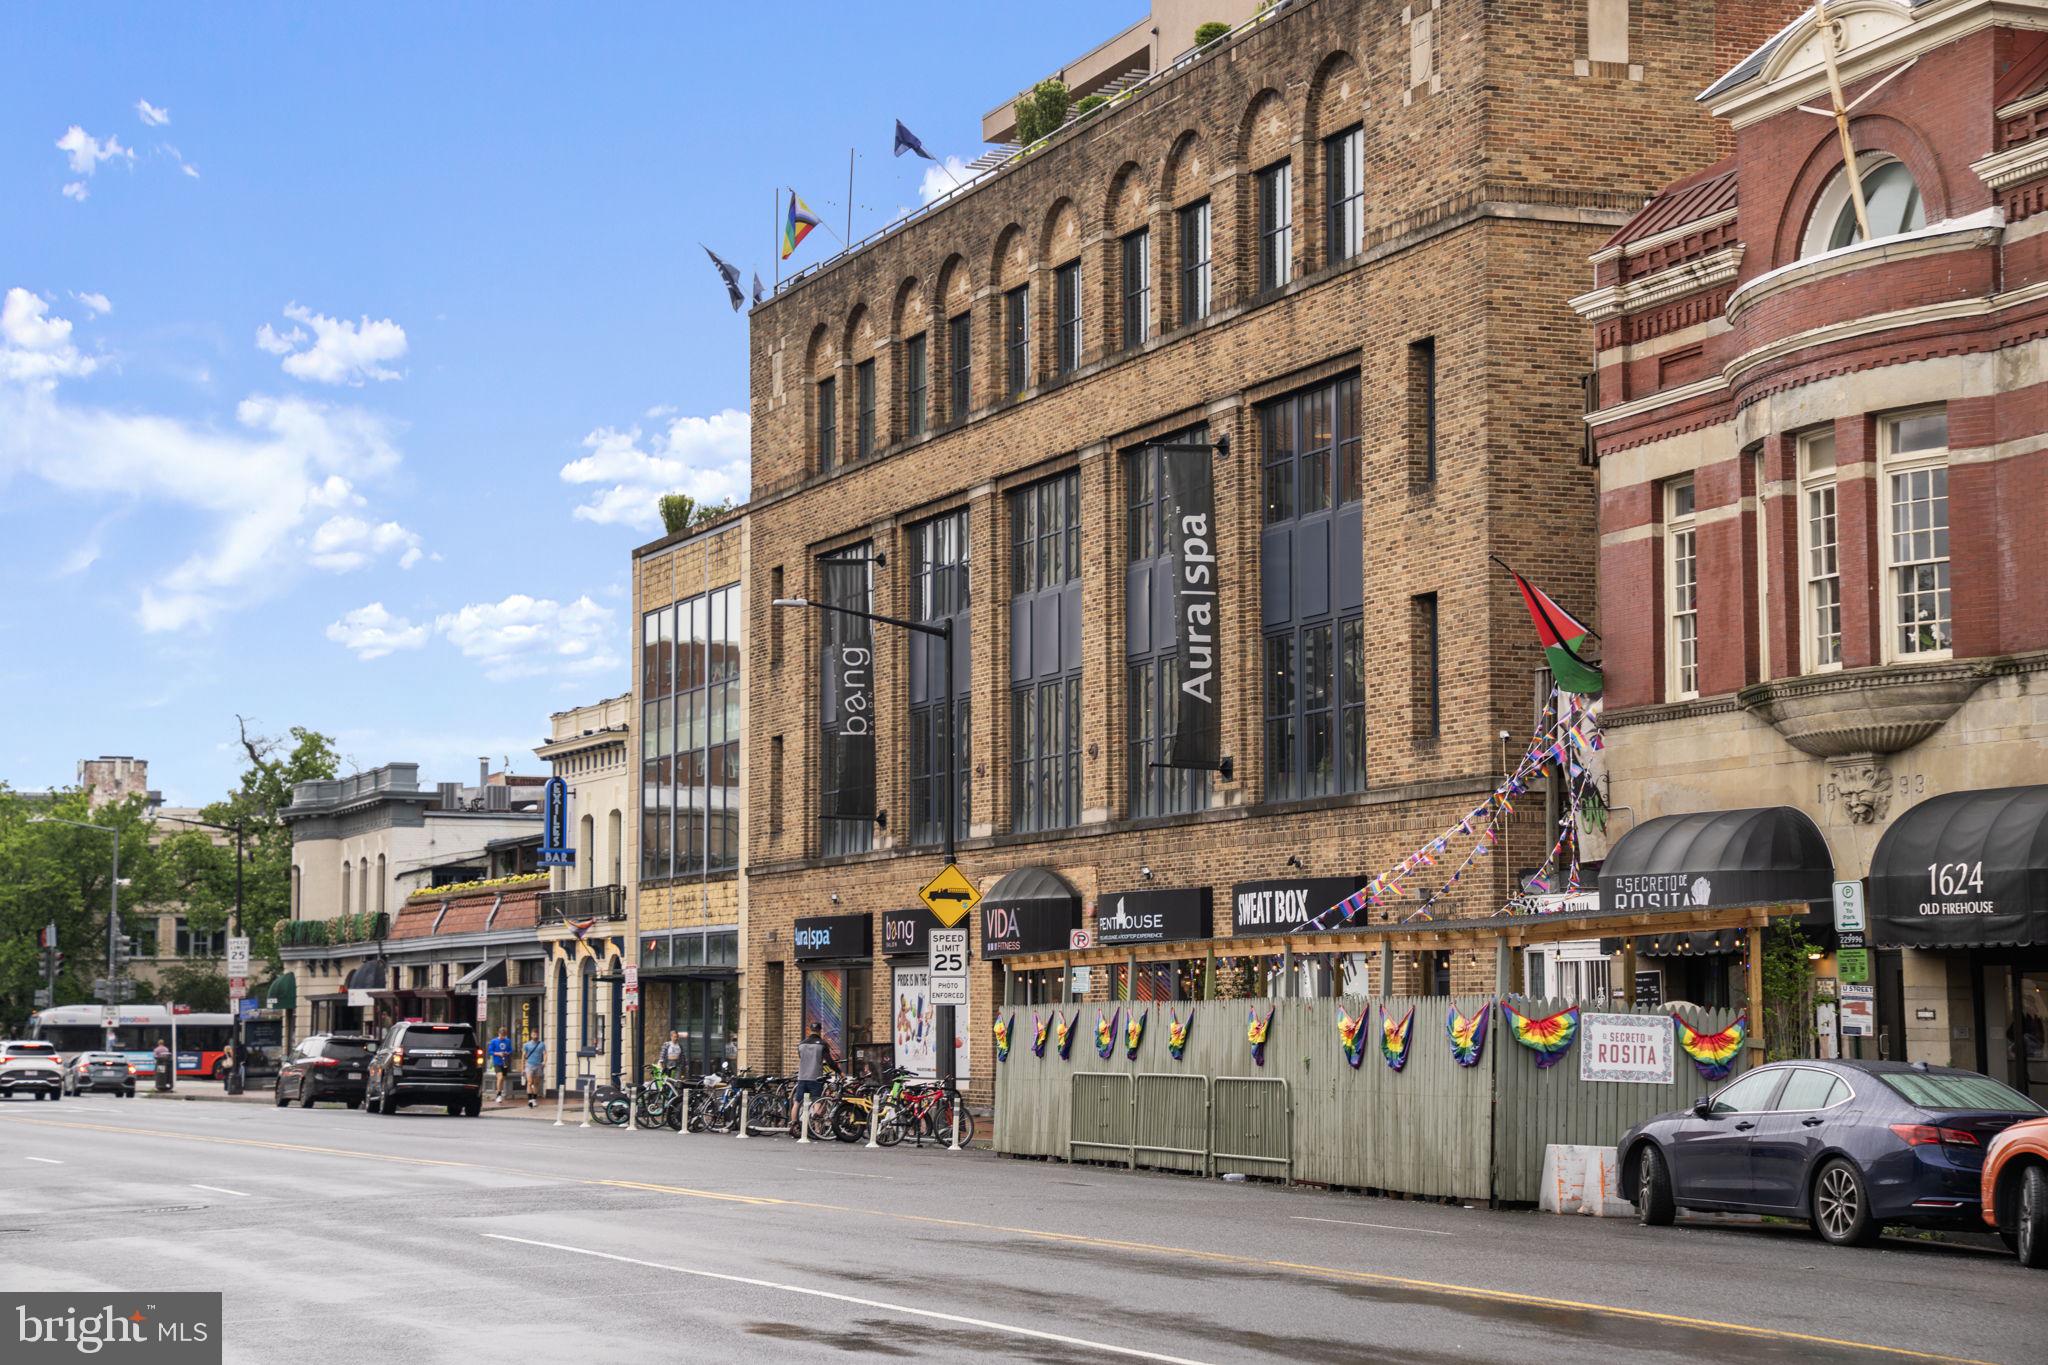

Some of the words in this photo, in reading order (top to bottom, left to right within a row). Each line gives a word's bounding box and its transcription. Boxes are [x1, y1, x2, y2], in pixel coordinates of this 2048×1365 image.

[840, 647, 870, 736] bang
[552, 782, 562, 847] EXILES
[545, 852, 568, 862] BAR
[1625, 875, 1677, 893] SECRETO
[1678, 874, 1688, 886] DE
[1927, 861, 1984, 896] 1624
[1100, 898, 1163, 930] PENTHOUSE
[1238, 891, 1272, 926] SWEAT
[1274, 889, 1309, 923] BOX
[1919, 902, 1940, 916] OLD
[1942, 901, 1994, 915] FIREHOUSE
[886, 915, 914, 946] bang
[986, 907, 1020, 939] VIDA
[932, 934, 964, 943] SPEED
[997, 941, 1021, 950] FITNESS
[1840, 936, 1863, 944] 229996
[231, 951, 246, 960] 25
[936, 944, 960, 952] LIMIT
[934, 954, 962, 971] 25
[897, 974, 909, 987] PRIDE
[909, 974, 914, 986] IS
[914, 974, 920, 986] IN
[919, 974, 928, 986] THE
[1610, 1032, 1646, 1043] SECRETO
[1599, 1044, 1656, 1065] ROSITA
